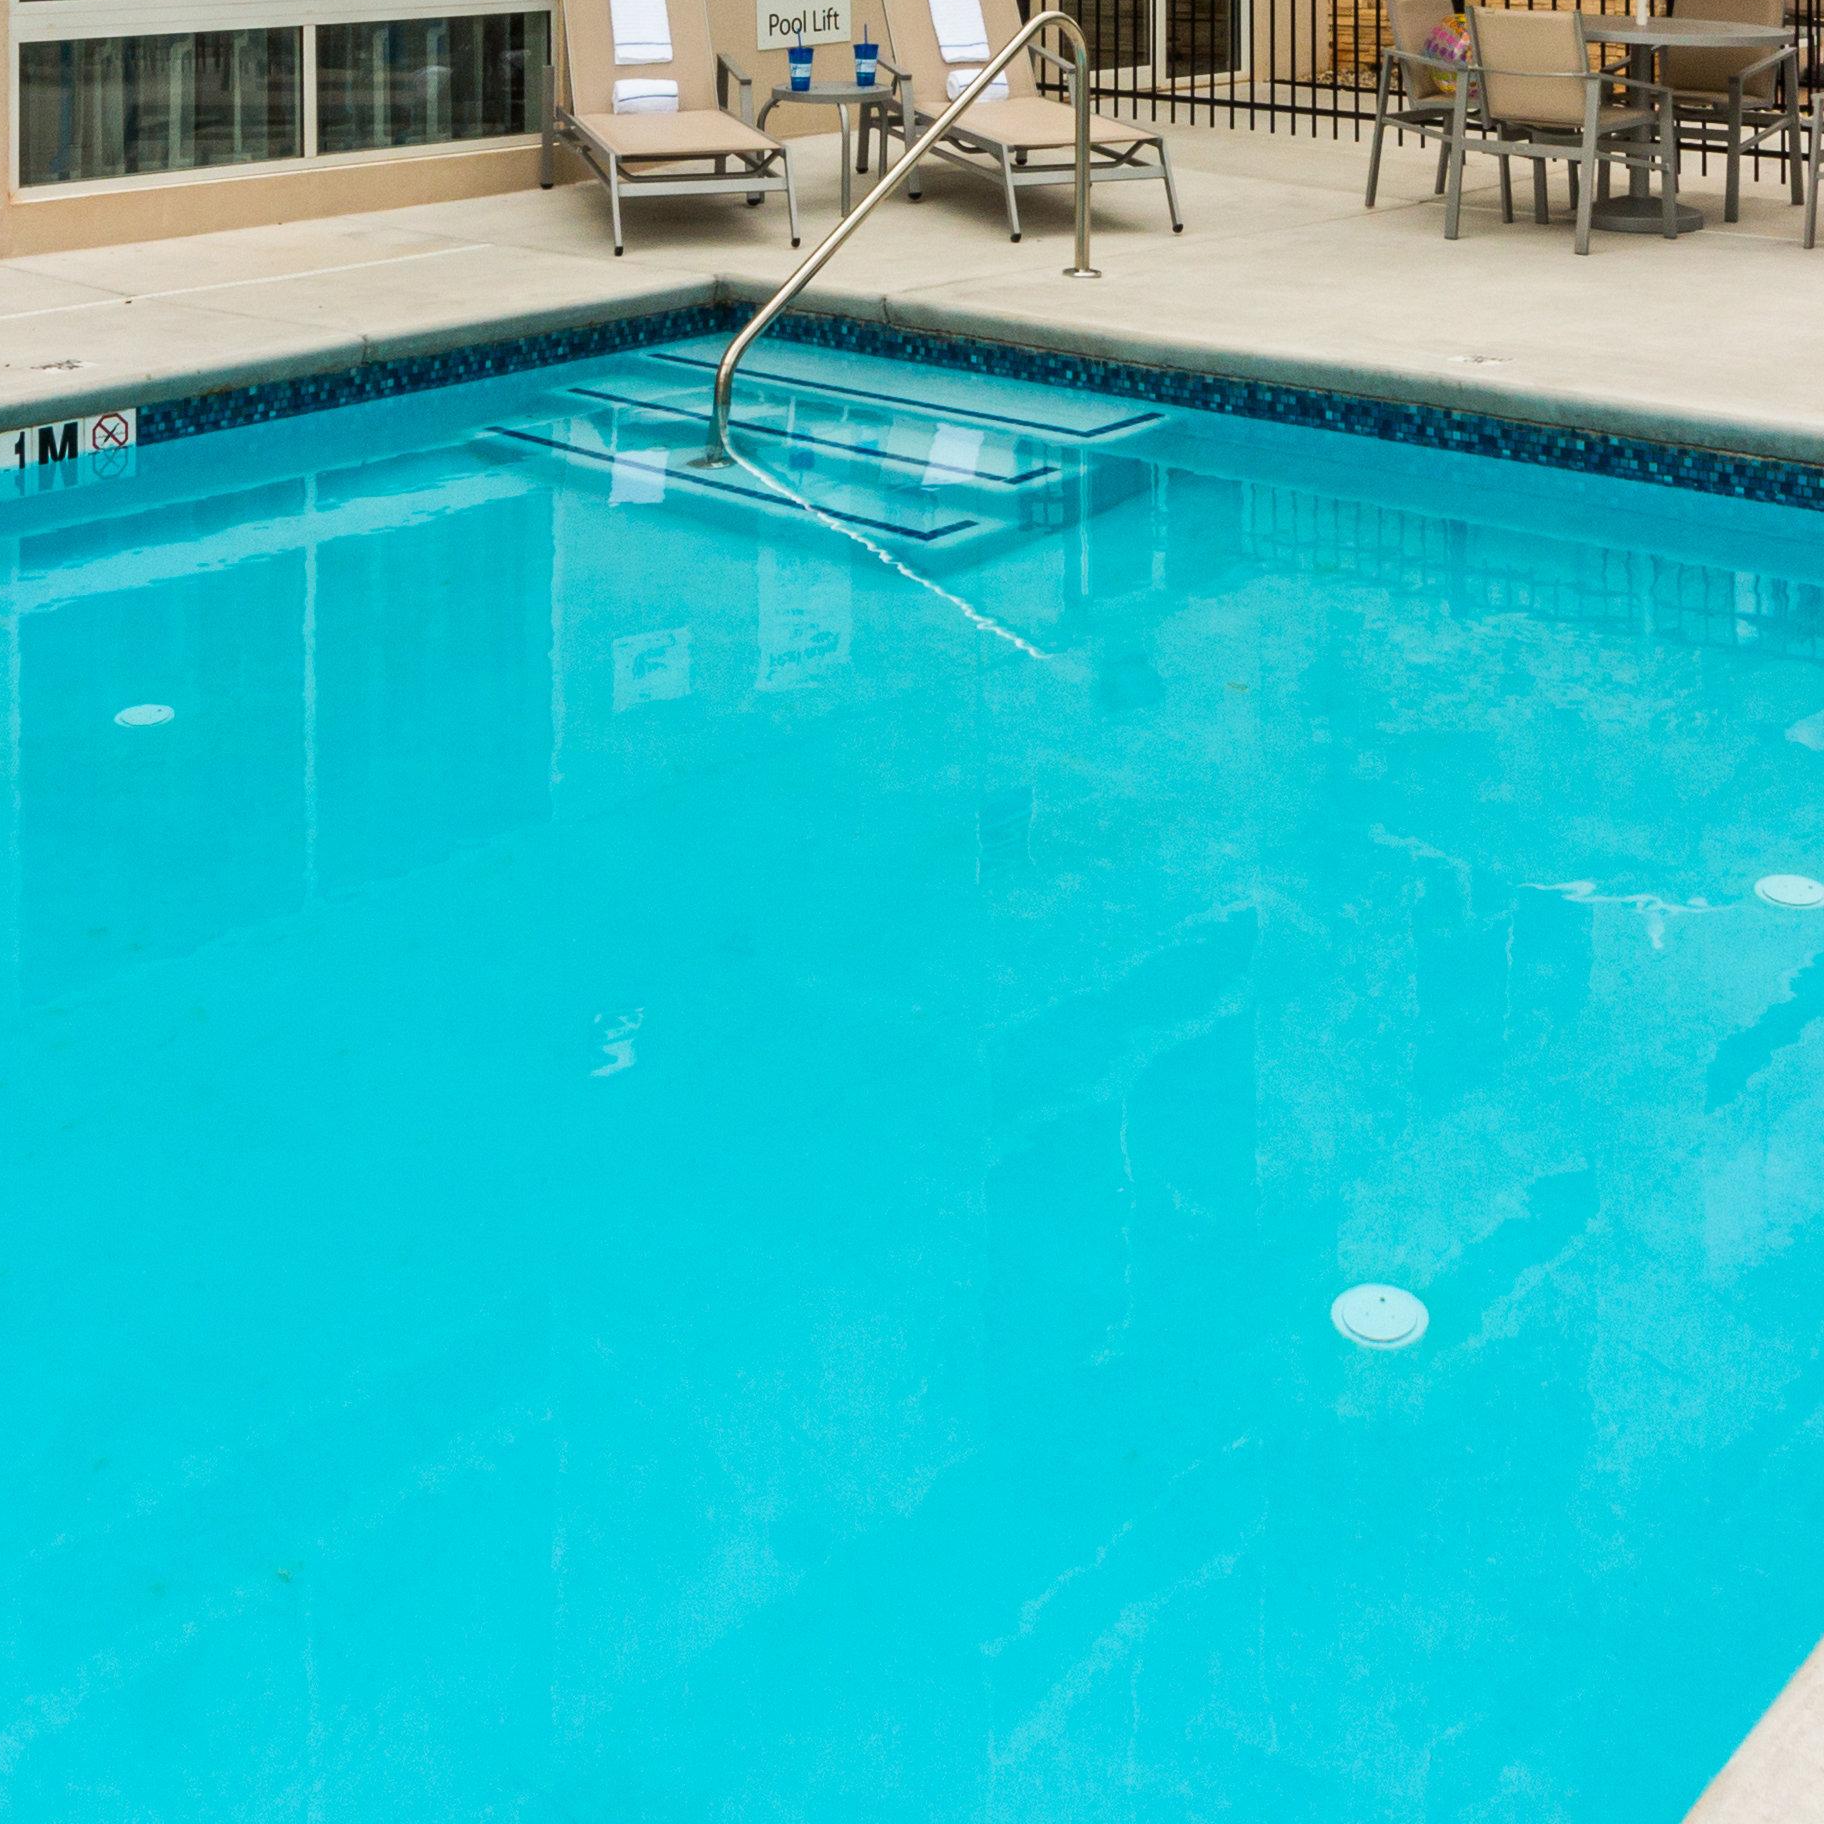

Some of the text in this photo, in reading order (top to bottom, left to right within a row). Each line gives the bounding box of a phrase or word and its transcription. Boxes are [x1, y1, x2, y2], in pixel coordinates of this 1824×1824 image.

[768, 7, 840, 37] Pool Lift
[38, 421, 79, 466] M
